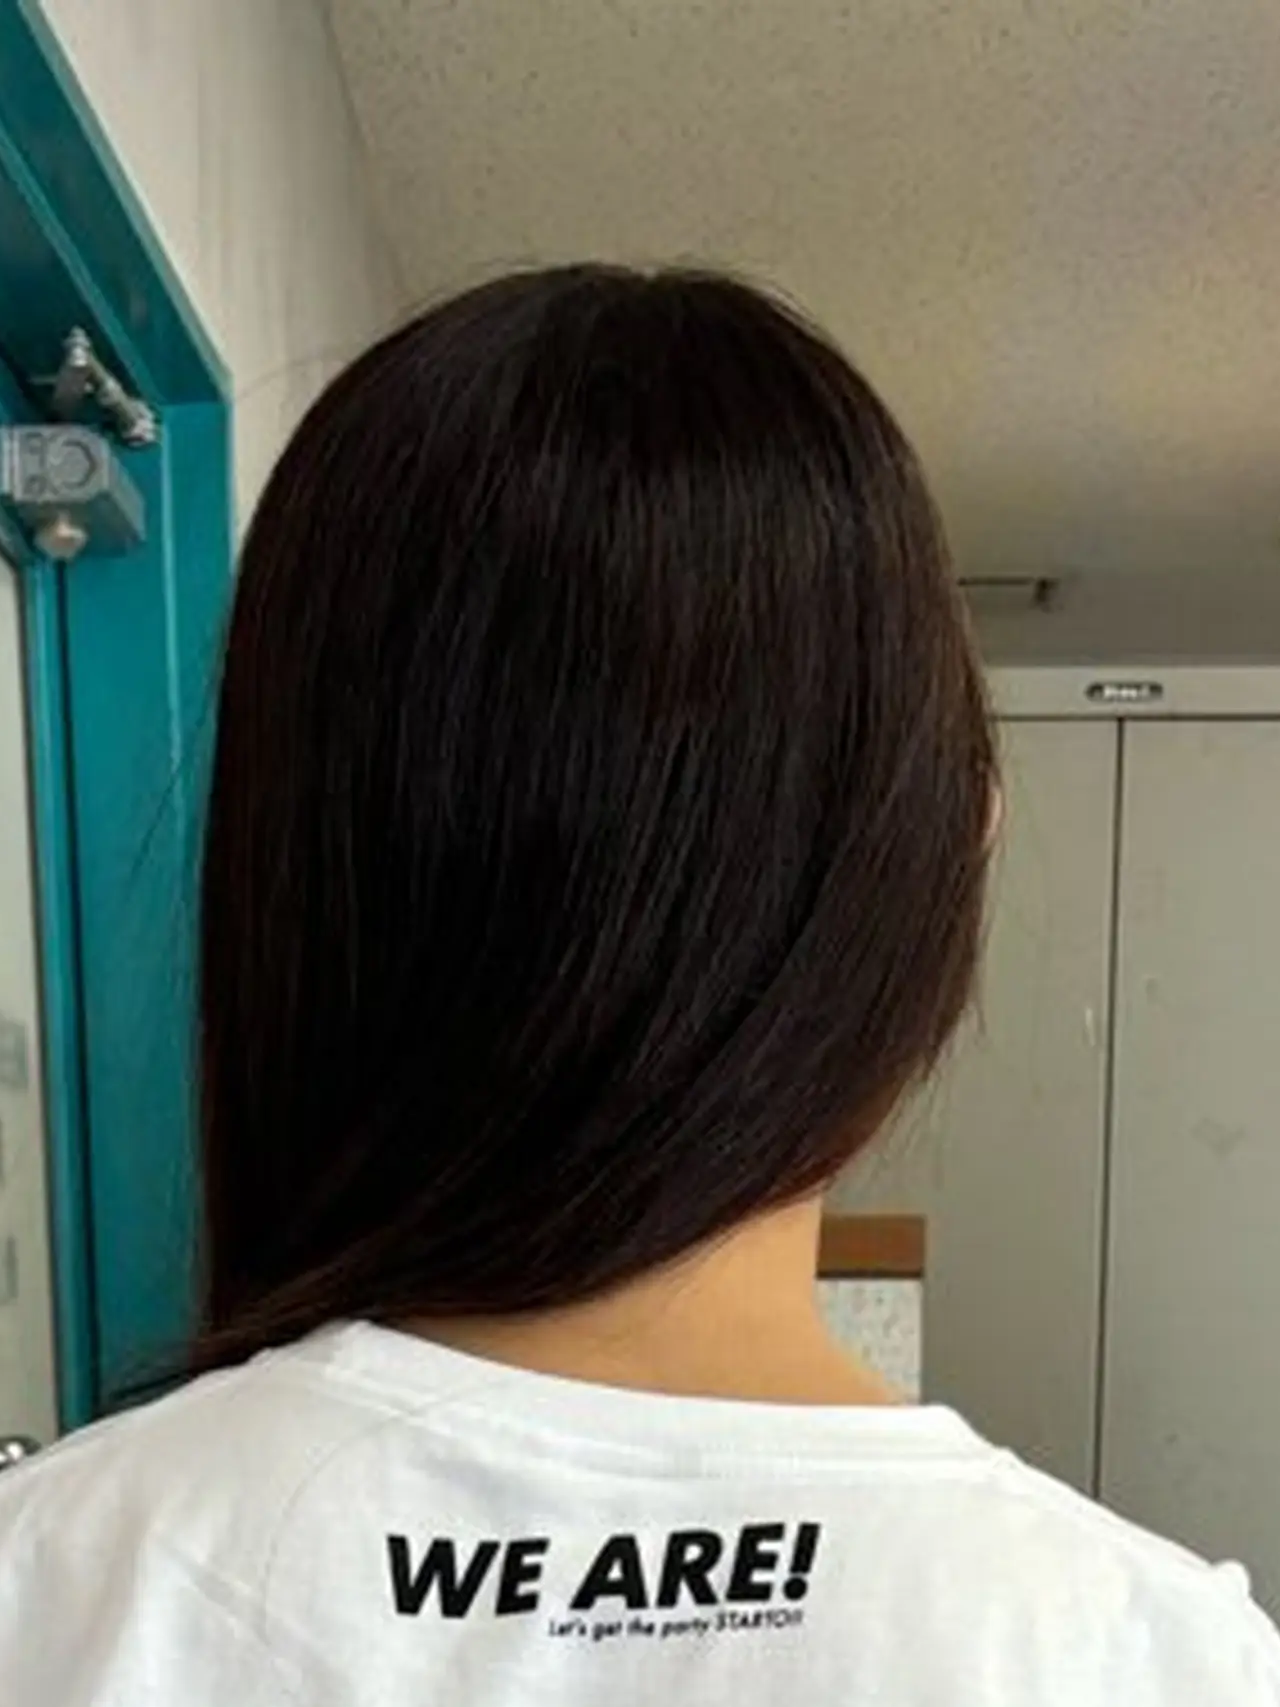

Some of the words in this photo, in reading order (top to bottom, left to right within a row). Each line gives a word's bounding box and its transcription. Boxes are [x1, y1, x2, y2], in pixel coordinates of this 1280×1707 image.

[387, 1533, 550, 1618] WE
[569, 1522, 821, 1610] ARE!
[626, 1616, 655, 1637] the
[660, 1615, 710, 1638] party
